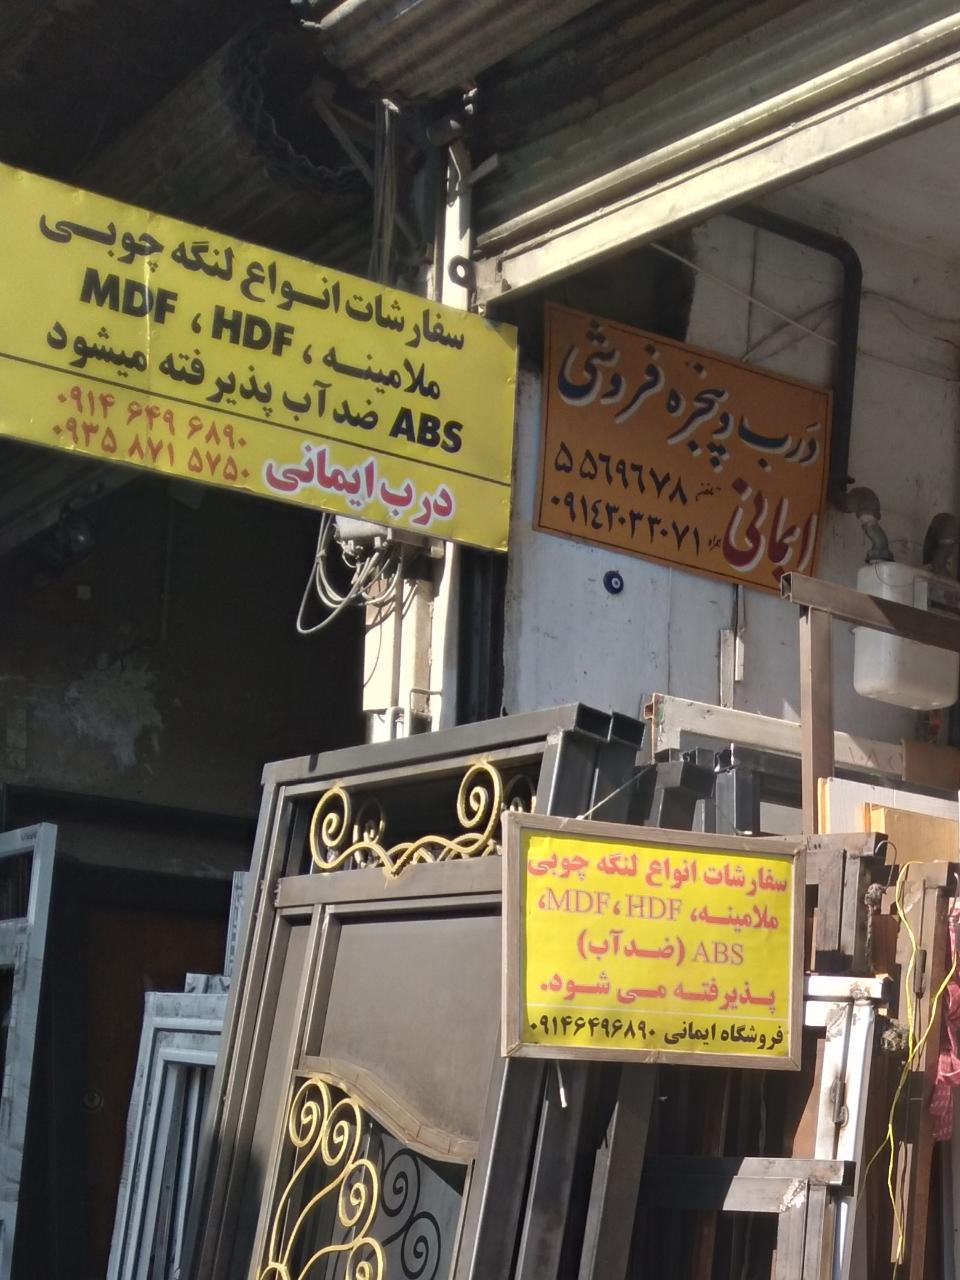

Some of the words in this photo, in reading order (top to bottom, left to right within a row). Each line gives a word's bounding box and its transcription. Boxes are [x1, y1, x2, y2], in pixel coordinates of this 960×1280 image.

[40, 212, 165, 272] چوبی
[171, 241, 234, 287] لنگه
[79, 267, 179, 324] MDF
[240, 260, 341, 314] انواع
[343, 296, 465, 350] سفارشات
[158, 350, 272, 418] پذیرفته
[557, 319, 665, 424] فروشی
[282, 379, 328, 421] آب
[333, 397, 379, 431] ضد
[389, 406, 464, 454] ABS
[128, 434, 175, 469] ۸۷۱
[266, 442, 376, 507] ایمانی
[379, 480, 455, 525] درب
[722, 477, 818, 582] ایمانی
[528, 852, 589, 880] چوبی
[597, 853, 637, 877] لنگه
[645, 859, 697, 889] انواع
[704, 865, 787, 897] سفارشات
[692, 941, 745, 966] ABS
[617, 981, 667, 1005] می
[673, 977, 776, 1014] پذیرفته
[664, 1020, 716, 1045] ایمانی
[720, 1024, 785, 1051] فروشگاه
